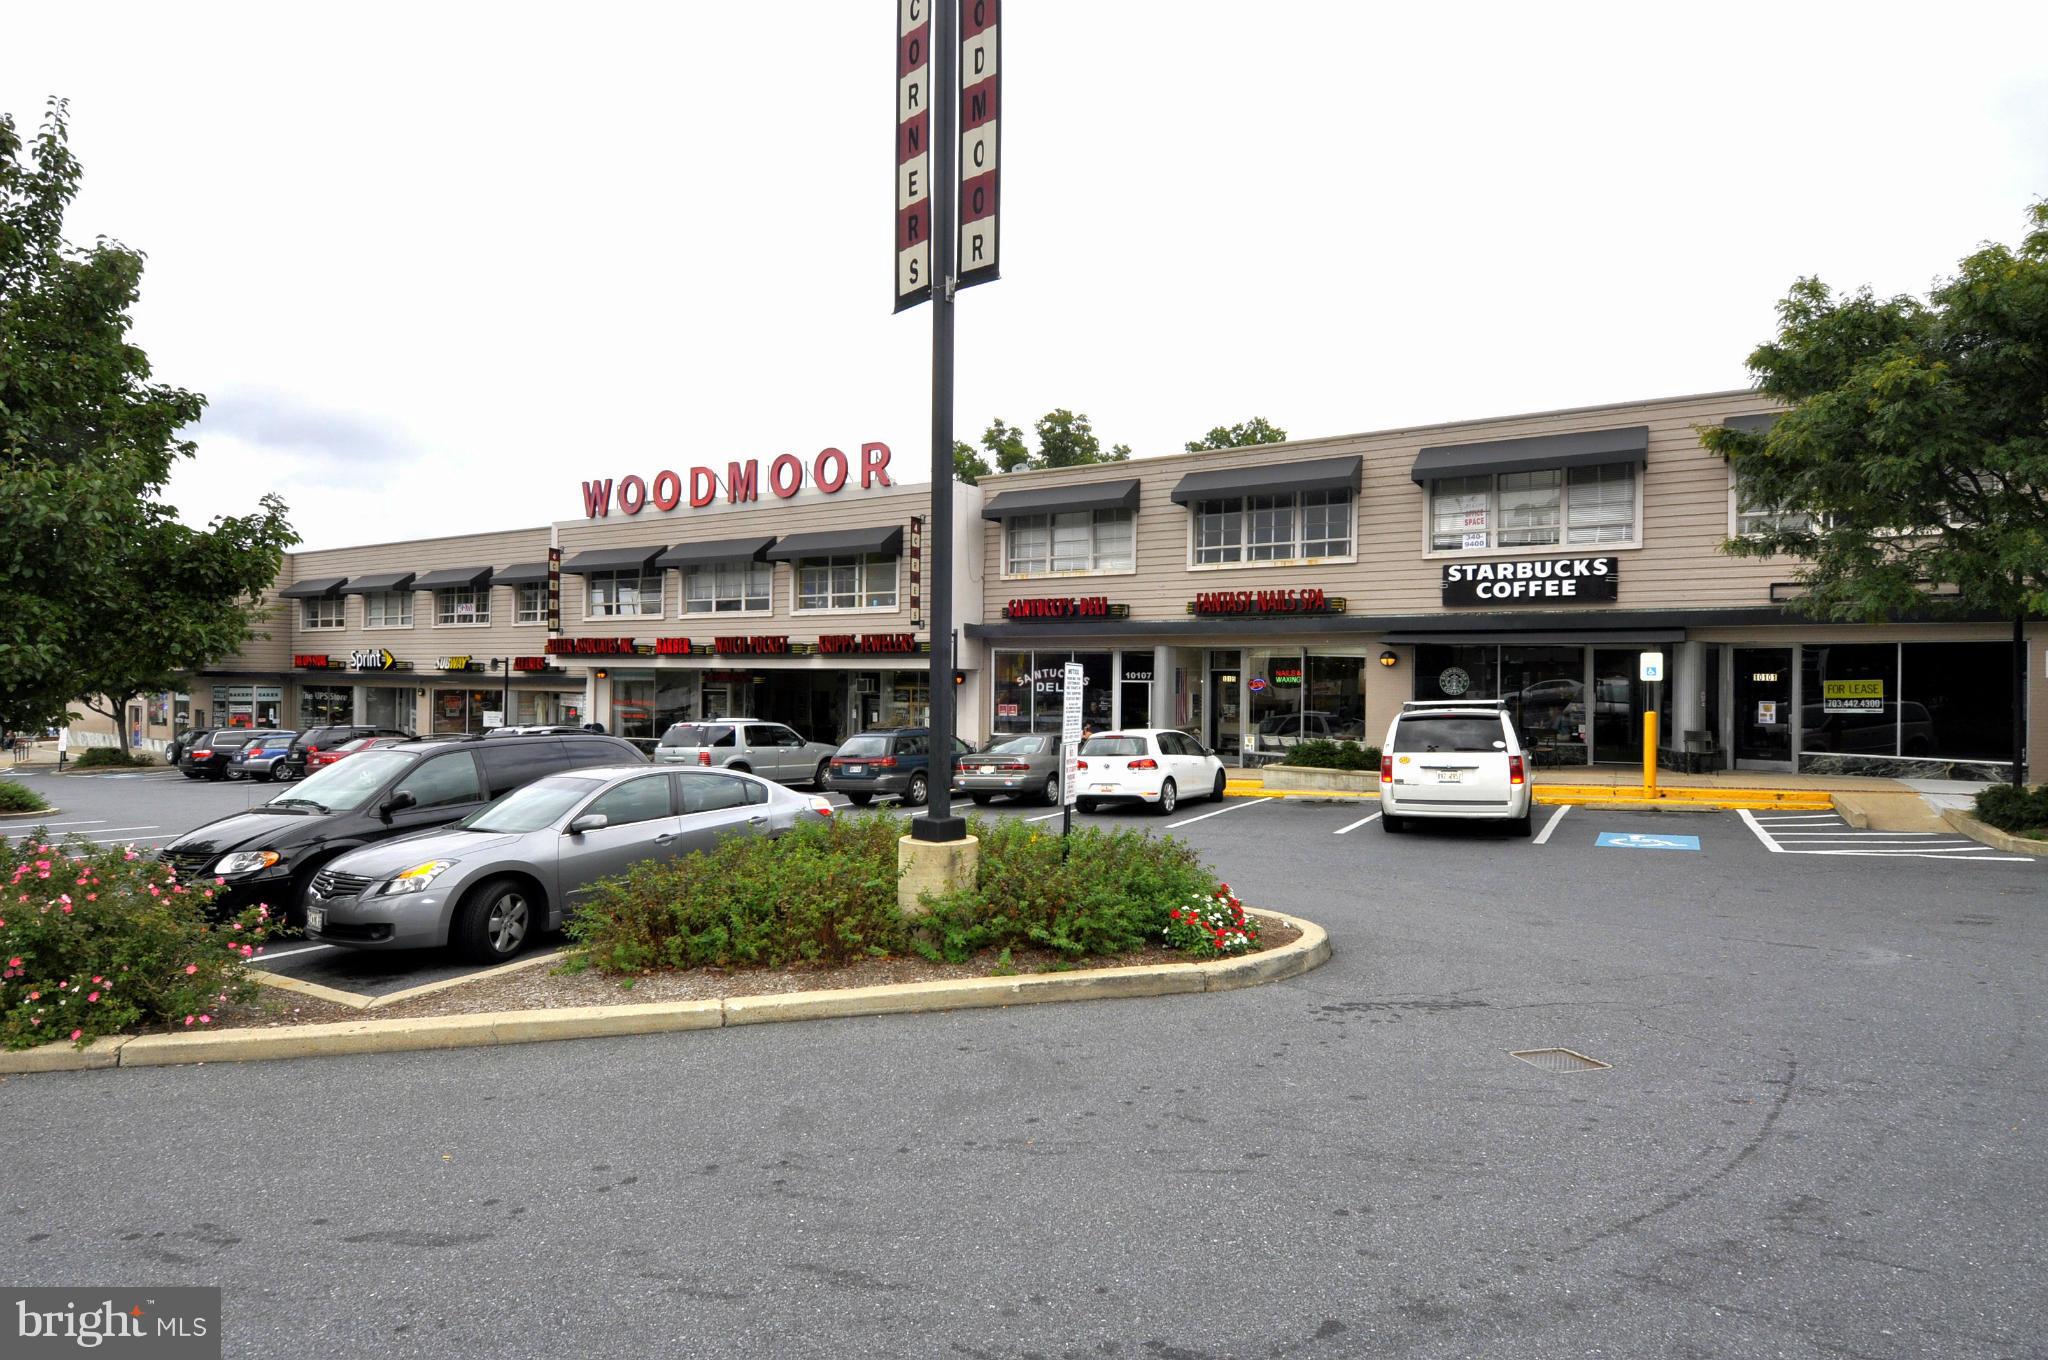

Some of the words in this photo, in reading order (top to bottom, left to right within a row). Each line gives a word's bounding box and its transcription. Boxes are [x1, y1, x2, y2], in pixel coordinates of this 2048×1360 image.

[907, 0, 920, 285] CORNERS
[582, 442, 891, 518] WOODMOOR
[1464, 517, 1485, 526] SPACE
[1448, 558, 1609, 582] STARBUCKS
[1476, 579, 1577, 598] COFFEE
[1008, 598, 1076, 617] SANTUCCI'S
[1079, 597, 1108, 616] DELI
[1196, 591, 1253, 613] FANTASY
[1257, 589, 1296, 611] NAILS
[1300, 588, 1326, 610] SPA
[656, 638, 690, 655] BARBER
[715, 636, 748, 654] WATCH
[750, 636, 788, 654] POCKET
[351, 650, 381, 671] Sprint
[434, 656, 469, 669] SUBWAY
[1016, 668, 1090, 687] SANTUCS
[1125, 672, 1152, 680] 10107
[1753, 673, 1778, 681] 10101
[1036, 682, 1064, 692] DEL
[1827, 684, 1845, 694] FOR
[1849, 684, 1880, 694] LEASE
[315, 692, 329, 700] UPS
[330, 692, 348, 701] Store
